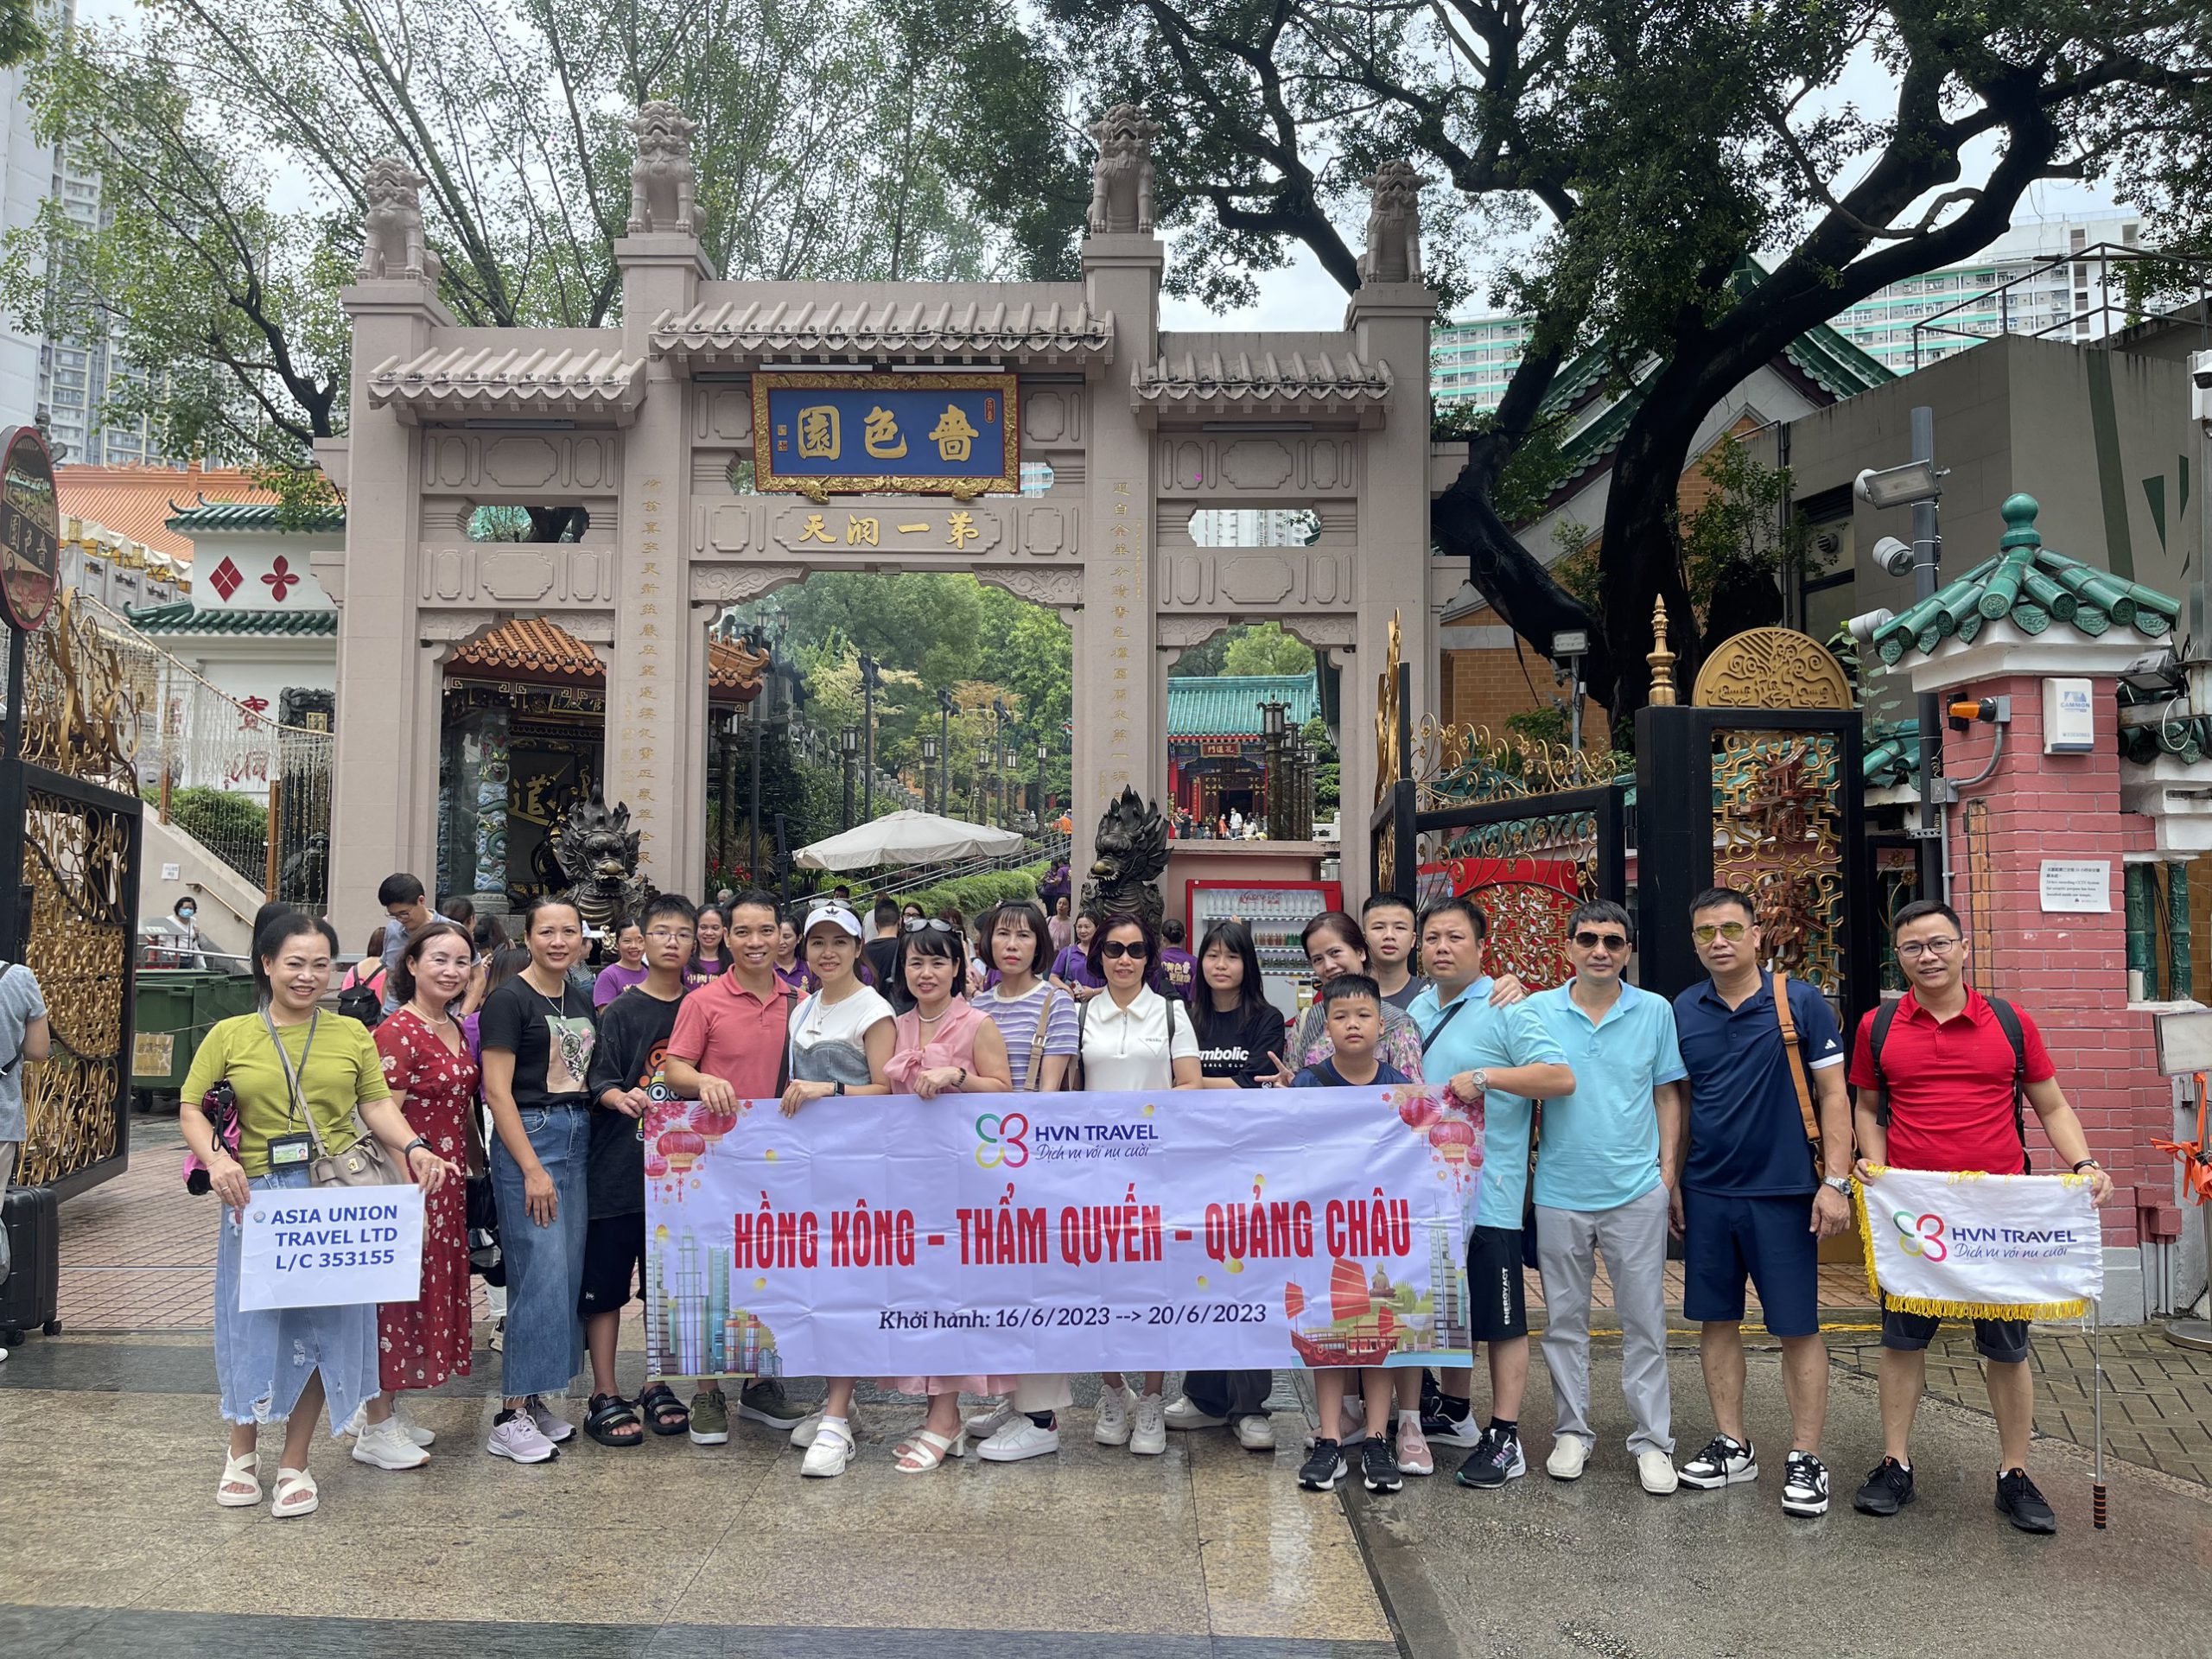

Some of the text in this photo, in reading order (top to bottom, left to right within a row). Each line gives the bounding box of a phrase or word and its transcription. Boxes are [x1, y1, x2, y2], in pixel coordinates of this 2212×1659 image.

[1035, 1124, 1159, 1141] HVN TRAVEL
[270, 1205, 397, 1225] ASIA UNION
[734, 1191, 818, 1268] HỒNG
[831, 1198, 914, 1268] KÔNG
[956, 1182, 1048, 1265] THẨM
[1060, 1183, 1162, 1267] QUYẾN
[1205, 1185, 1313, 1264] QUẢNG
[1325, 1186, 1411, 1259] CHÂU
[275, 1227, 397, 1247] TRAVEL LTD
[1952, 1227, 2077, 1243] HVN TRAVEL
[276, 1249, 395, 1272] L/C 353155
[879, 1308, 936, 1330] Khởi
[940, 1309, 990, 1329] hành:
[995, 1307, 1110, 1328] 16/6/2023
[1147, 1304, 1267, 1325] 20/6/2023
